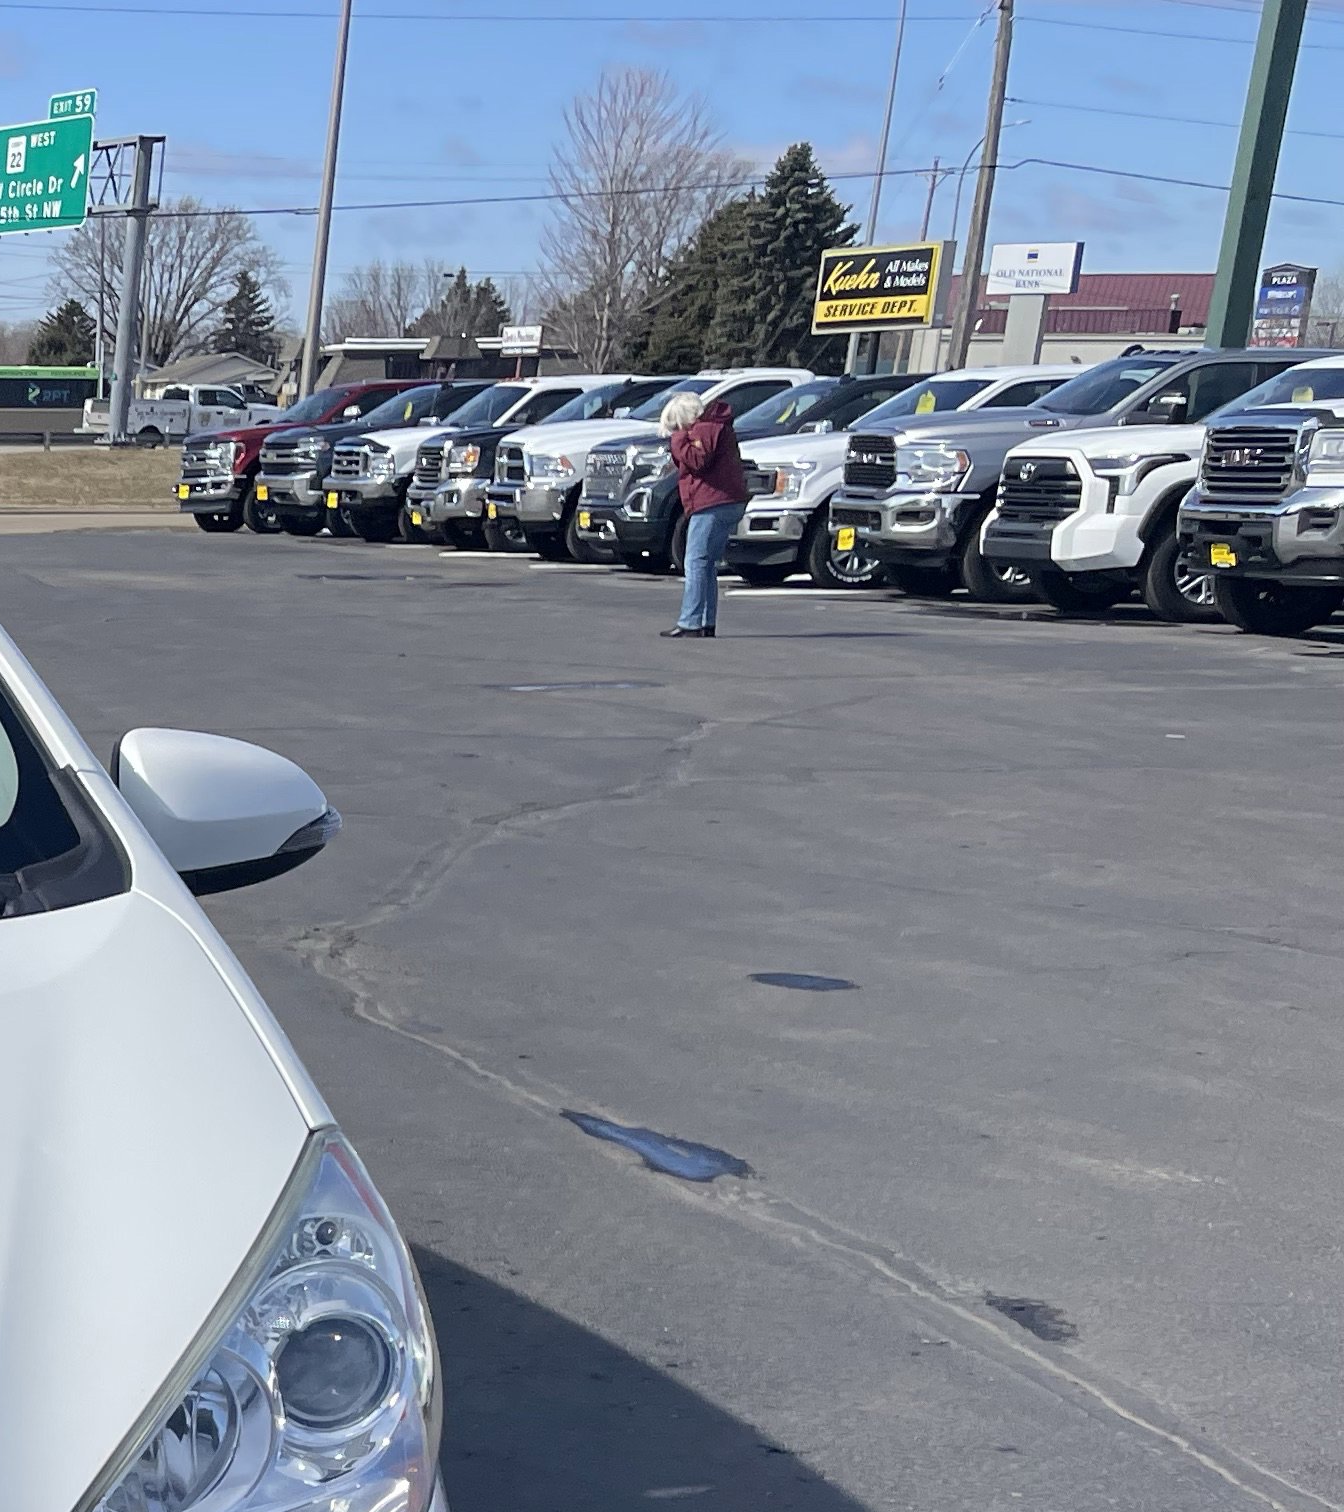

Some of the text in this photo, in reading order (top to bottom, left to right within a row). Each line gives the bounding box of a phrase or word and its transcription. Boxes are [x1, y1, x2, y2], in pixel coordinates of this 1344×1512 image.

[53, 94, 92, 114] EXIT 59
[30, 130, 56, 148] WEST
[10, 152, 22, 168] 22
[8, 179, 44, 199] Circle
[48, 175, 64, 194] Dr
[25, 203, 38, 221] St
[42, 200, 62, 218] NW
[885, 258, 929, 274] All Makes
[996, 268, 1064, 278] OLD NATIONAL
[823, 258, 881, 296] Kuehn
[893, 273, 927, 288] Models
[1015, 279, 1041, 289] BANK
[1271, 276, 1297, 285] PLAZA
[823, 299, 918, 318] SERVICE DEPT.
